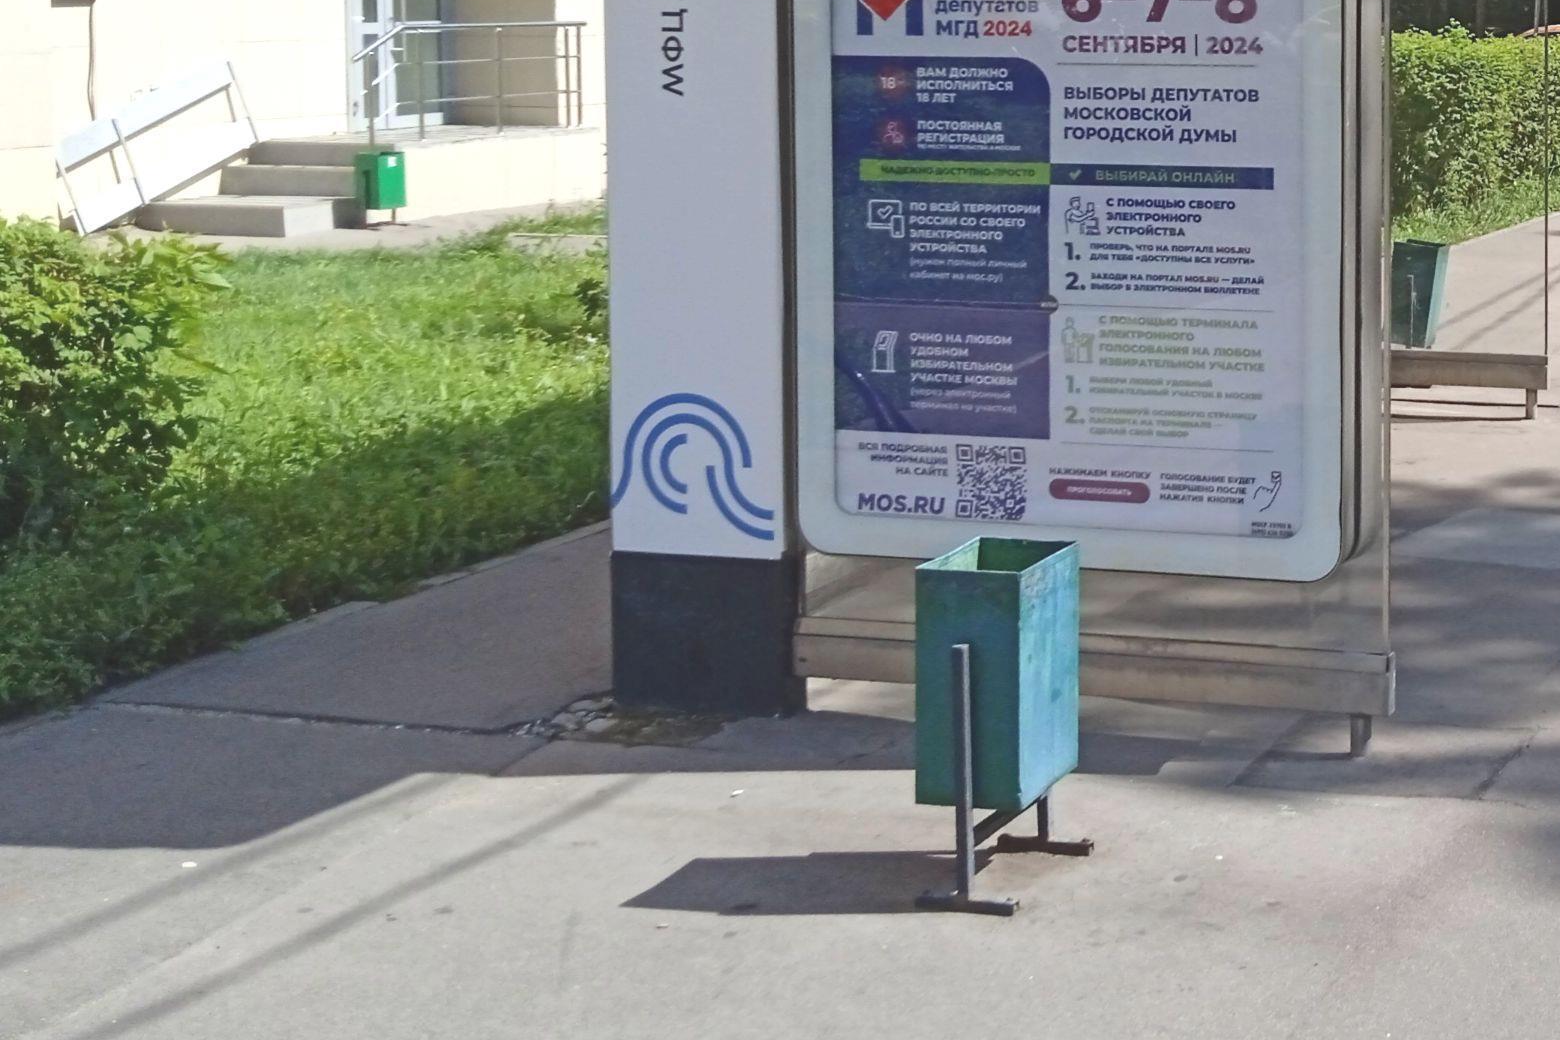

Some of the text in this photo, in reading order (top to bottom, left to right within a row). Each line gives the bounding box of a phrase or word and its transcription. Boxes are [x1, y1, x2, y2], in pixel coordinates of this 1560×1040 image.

[935, 0, 1039, 15] депутатов
[935, 20, 1032, 39] МГД 2024
[1062, 35, 1264, 56] СЕНТЯБРЯ 2024
[661, 8, 688, 97] МФЦ
[917, 67, 1008, 78] ВАМ ДОЛЖНО
[917, 80, 1014, 91] ИСПОЛНИТЬСЯ
[916, 93, 957, 103] 18 ЛЕТ
[1064, 87, 1260, 103] ВЫБОРЫ ДЕПУТАТОВ
[1064, 105, 1191, 121] МОСКОВСКОЙ
[917, 120, 1002, 131] ПОСТОЯННАЯ
[917, 133, 1005, 144] РЕГИСТРАЦИЯ
[1064, 125, 1237, 144] ГОРОДСКОЙ ДУМЫ
[1096, 169, 1235, 184] ВЫБИРАЙ ОНЛАЙН
[910, 201, 1041, 214] ПО ВСЕЙ ТЕРРИТОРИИ
[1106, 198, 1235, 210] С ПОМОЩЬЮ СВОЕГО
[910, 215, 1026, 228] РОССИИ СО СВОЕГО
[1106, 212, 1202, 223] ЭЛЕКТРОННОГО
[910, 229, 1003, 240] ЭЛЕКТРОННОГО
[1106, 225, 1185, 236] УСТРОЙСТВА
[910, 241, 987, 253] УСТРОЙСТВА
[1064, 242, 1081, 261] 1.
[1136, 244, 1154, 252] ЧТО
[1065, 271, 1086, 290] 2.
[910, 332, 1012, 344] ОЧНО НА ЛЮБОМ
[910, 346, 969, 356] УДОБНОМ
[910, 359, 1013, 372] ИЗБИРАТЕЛЬНОМ
[910, 373, 1018, 386] УЧАСТКЕ МОСКВЫ
[914, 467, 948, 476] САЙТЕ
[858, 493, 945, 514] MOS.RU
